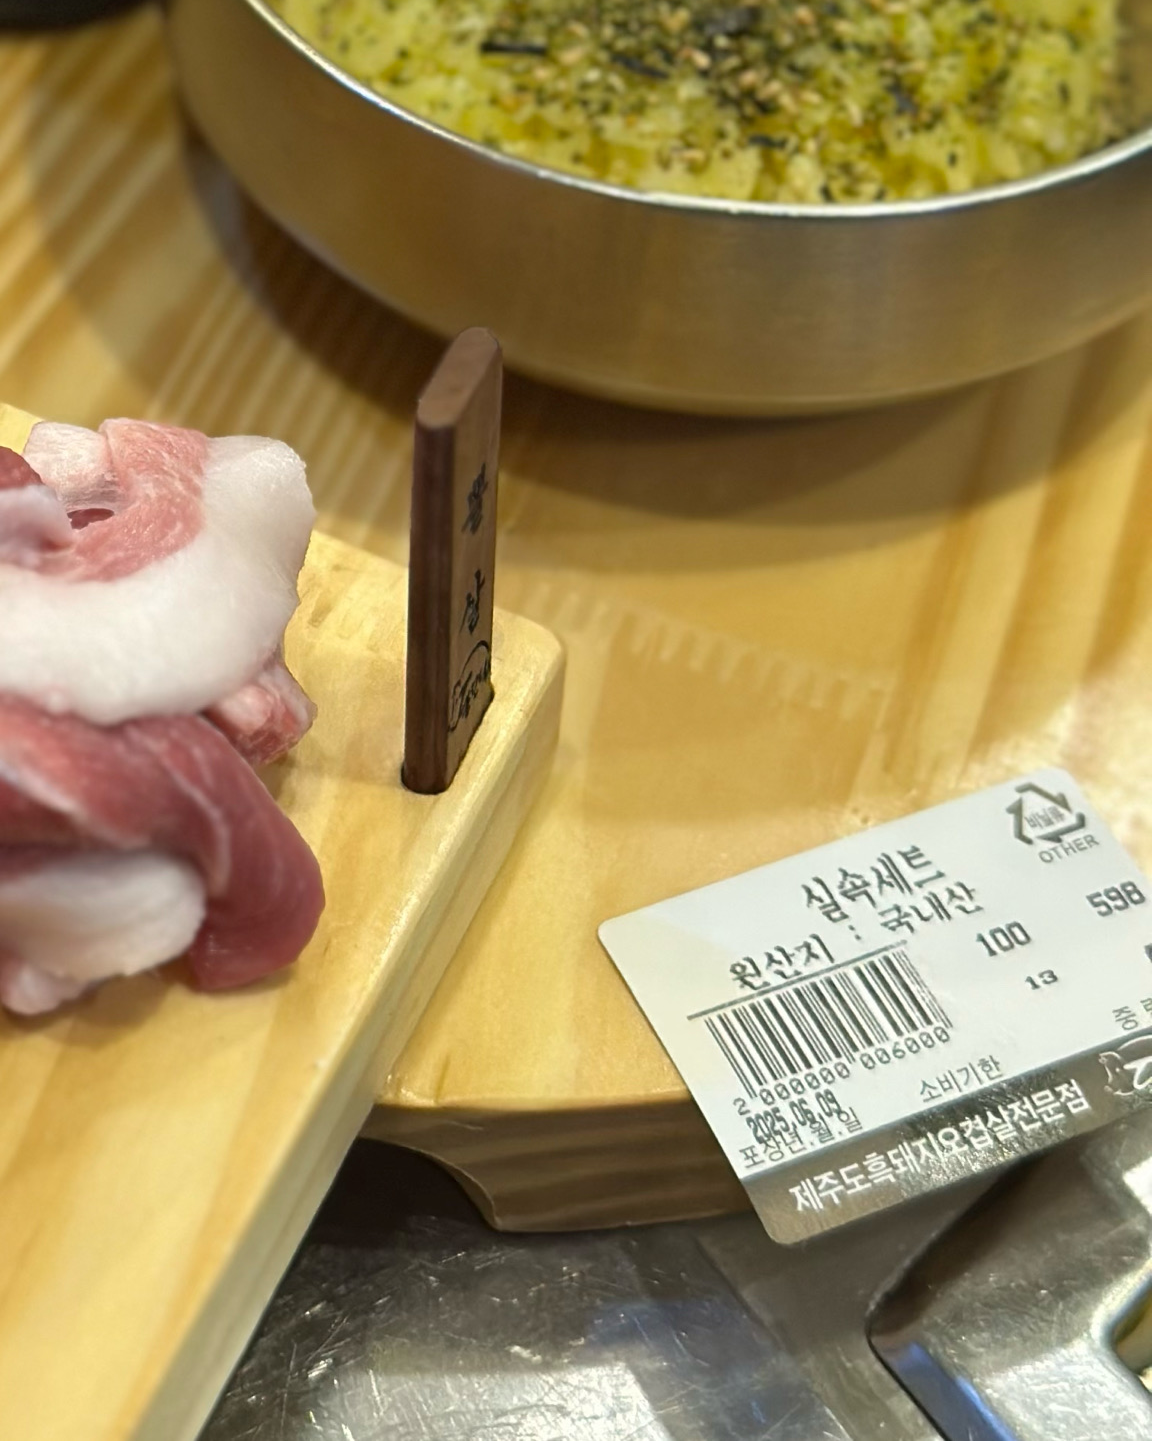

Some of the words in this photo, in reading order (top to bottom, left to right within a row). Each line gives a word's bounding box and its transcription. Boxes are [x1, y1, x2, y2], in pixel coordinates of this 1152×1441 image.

[1038, 834, 1100, 863] OTHER
[802, 845, 946, 923] 실속세트
[1086, 881, 1146, 917] 598
[729, 933, 835, 990] 원산지
[878, 881, 984, 934] 국내산
[976, 921, 1032, 957] 100
[1025, 969, 1058, 990] 13
[919, 1054, 1004, 1103] 소비기한
